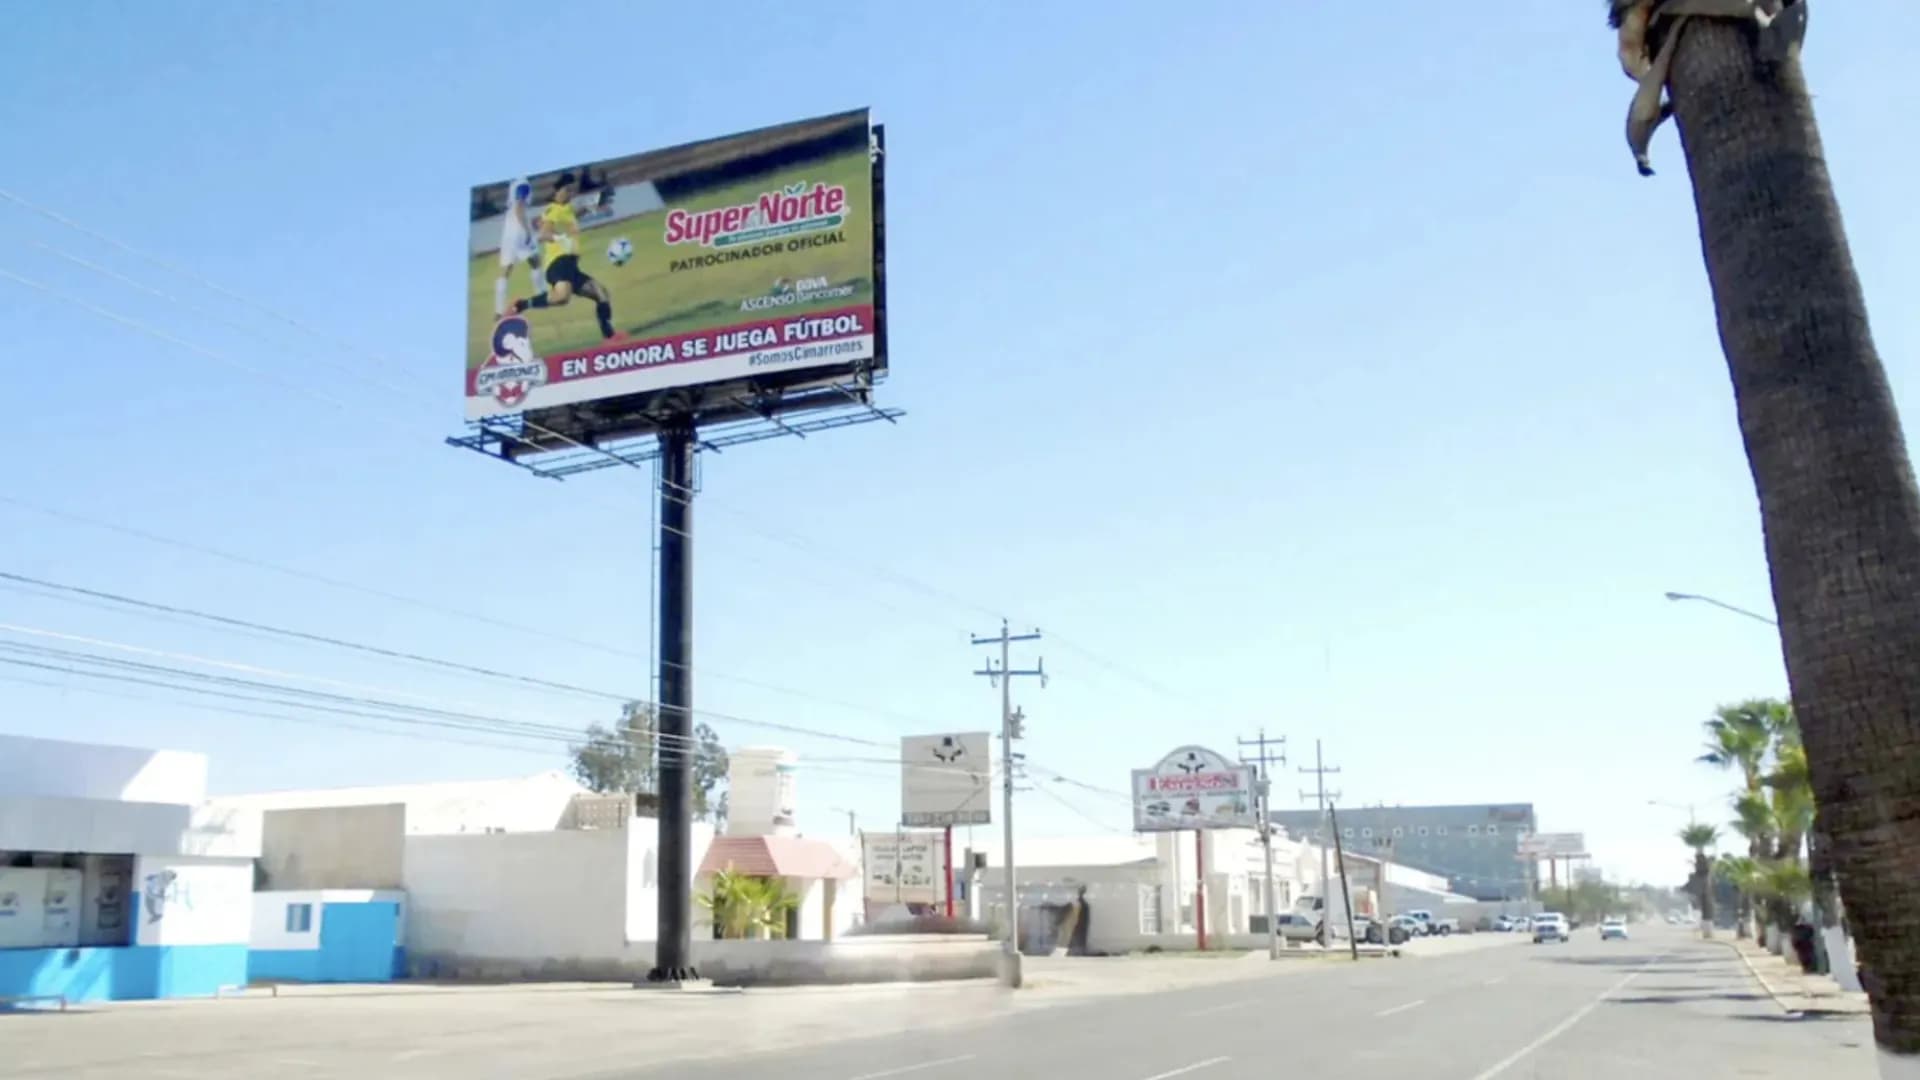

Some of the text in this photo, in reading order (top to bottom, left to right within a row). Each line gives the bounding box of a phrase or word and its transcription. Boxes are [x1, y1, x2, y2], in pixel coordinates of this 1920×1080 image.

[669, 242, 784, 272] PATROCINADOR
[787, 231, 847, 253] OFICIAL
[562, 314, 863, 377] EN SONORA SE JUEGA FÚTBOL
[748, 340, 863, 366] #SomosCimarrones
